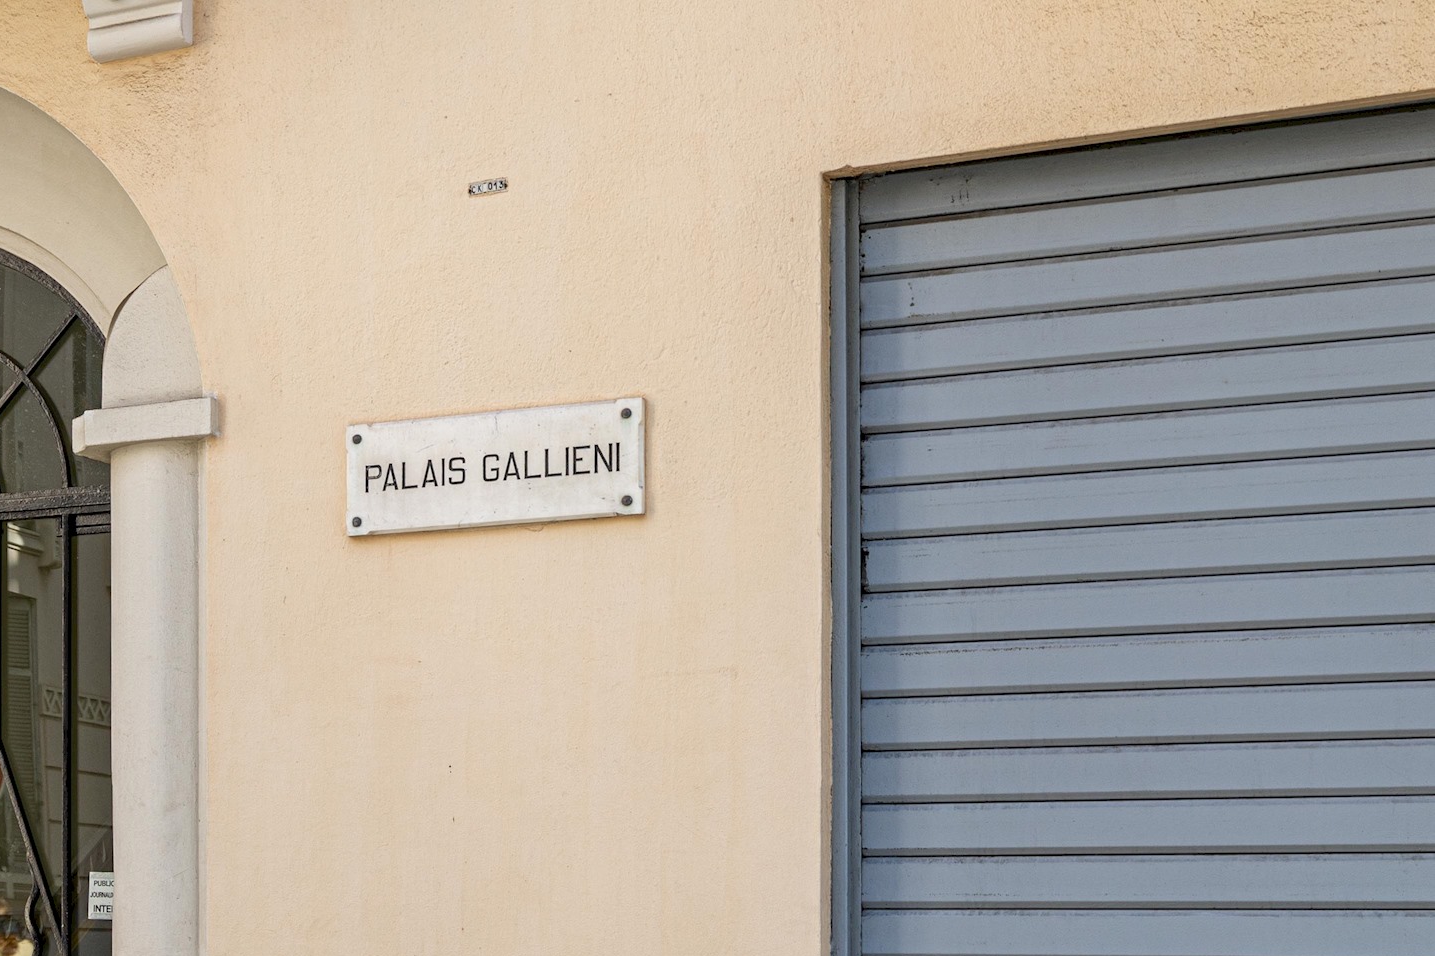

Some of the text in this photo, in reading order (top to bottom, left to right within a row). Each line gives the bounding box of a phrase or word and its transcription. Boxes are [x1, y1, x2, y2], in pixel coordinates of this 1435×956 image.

[488, 180, 504, 191] 013
[364, 441, 621, 493] PALAIS GALLIENI
[93, 904, 113, 913] INTE
